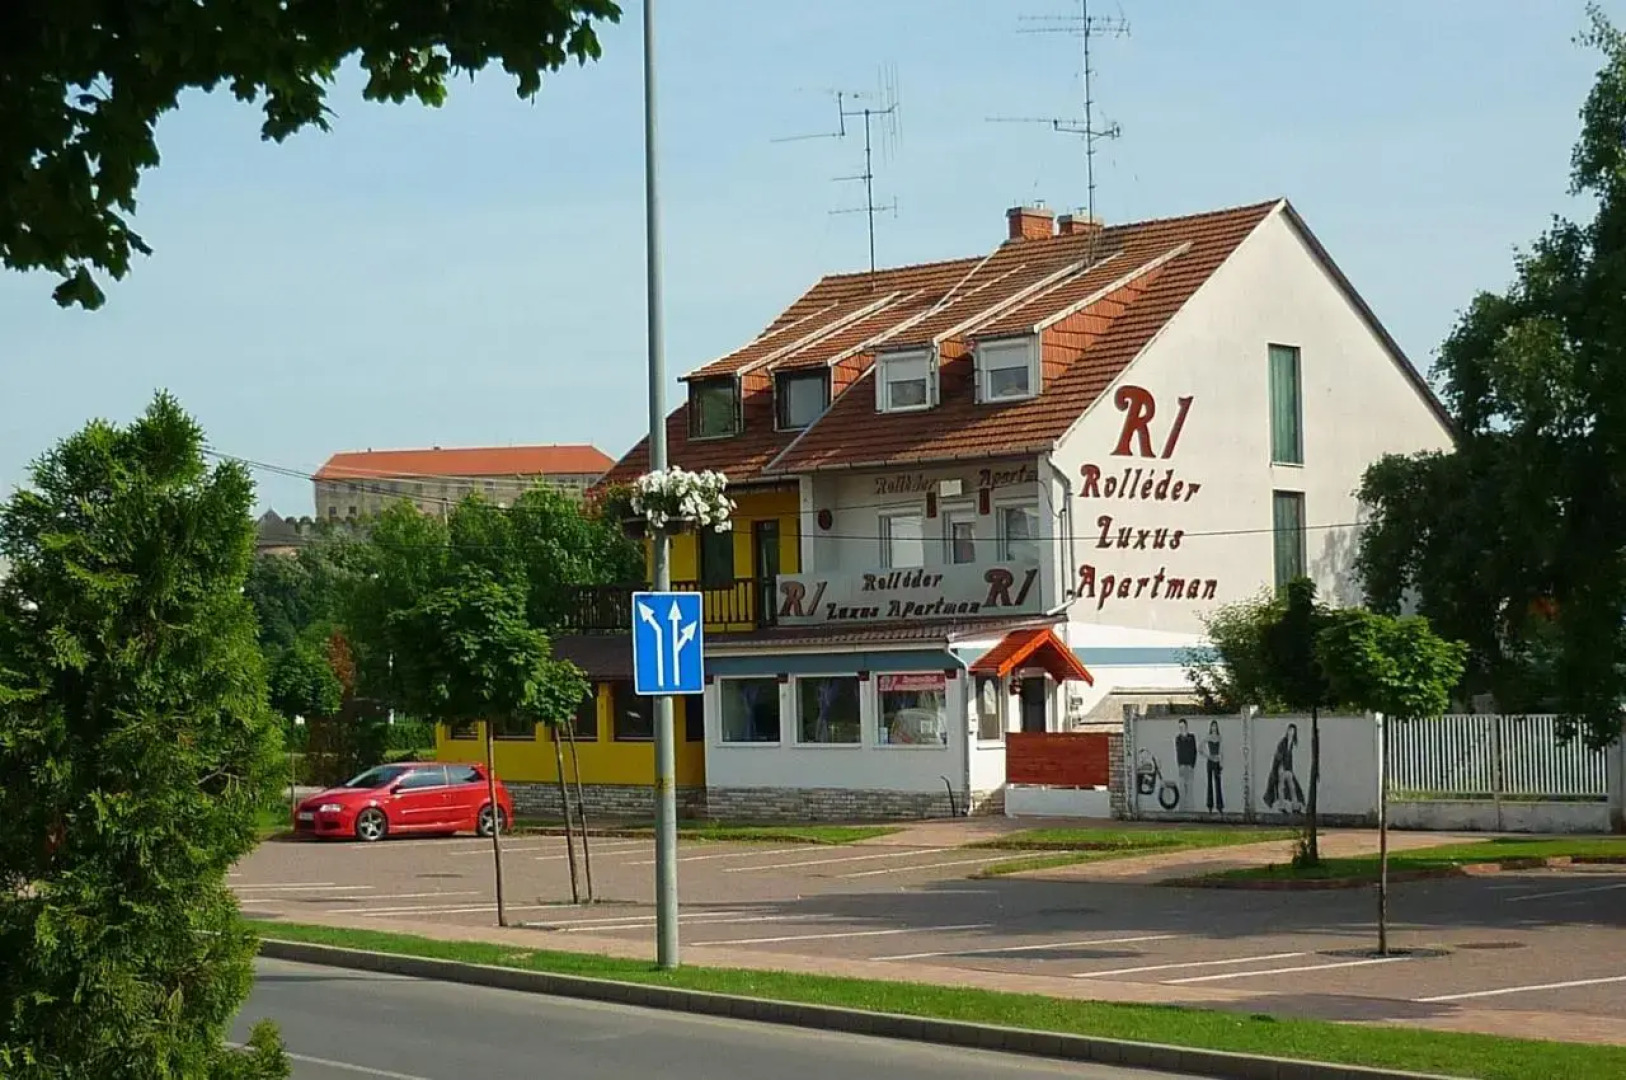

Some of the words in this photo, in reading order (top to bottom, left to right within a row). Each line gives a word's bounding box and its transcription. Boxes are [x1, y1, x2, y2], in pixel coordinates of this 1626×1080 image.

[1079, 464, 1202, 502] Rolléder
[1095, 515, 1185, 550] Luxus
[1076, 565, 1218, 611] Apartman
[826, 602, 879, 620] Luxus
[886, 596, 981, 619] Apartman
